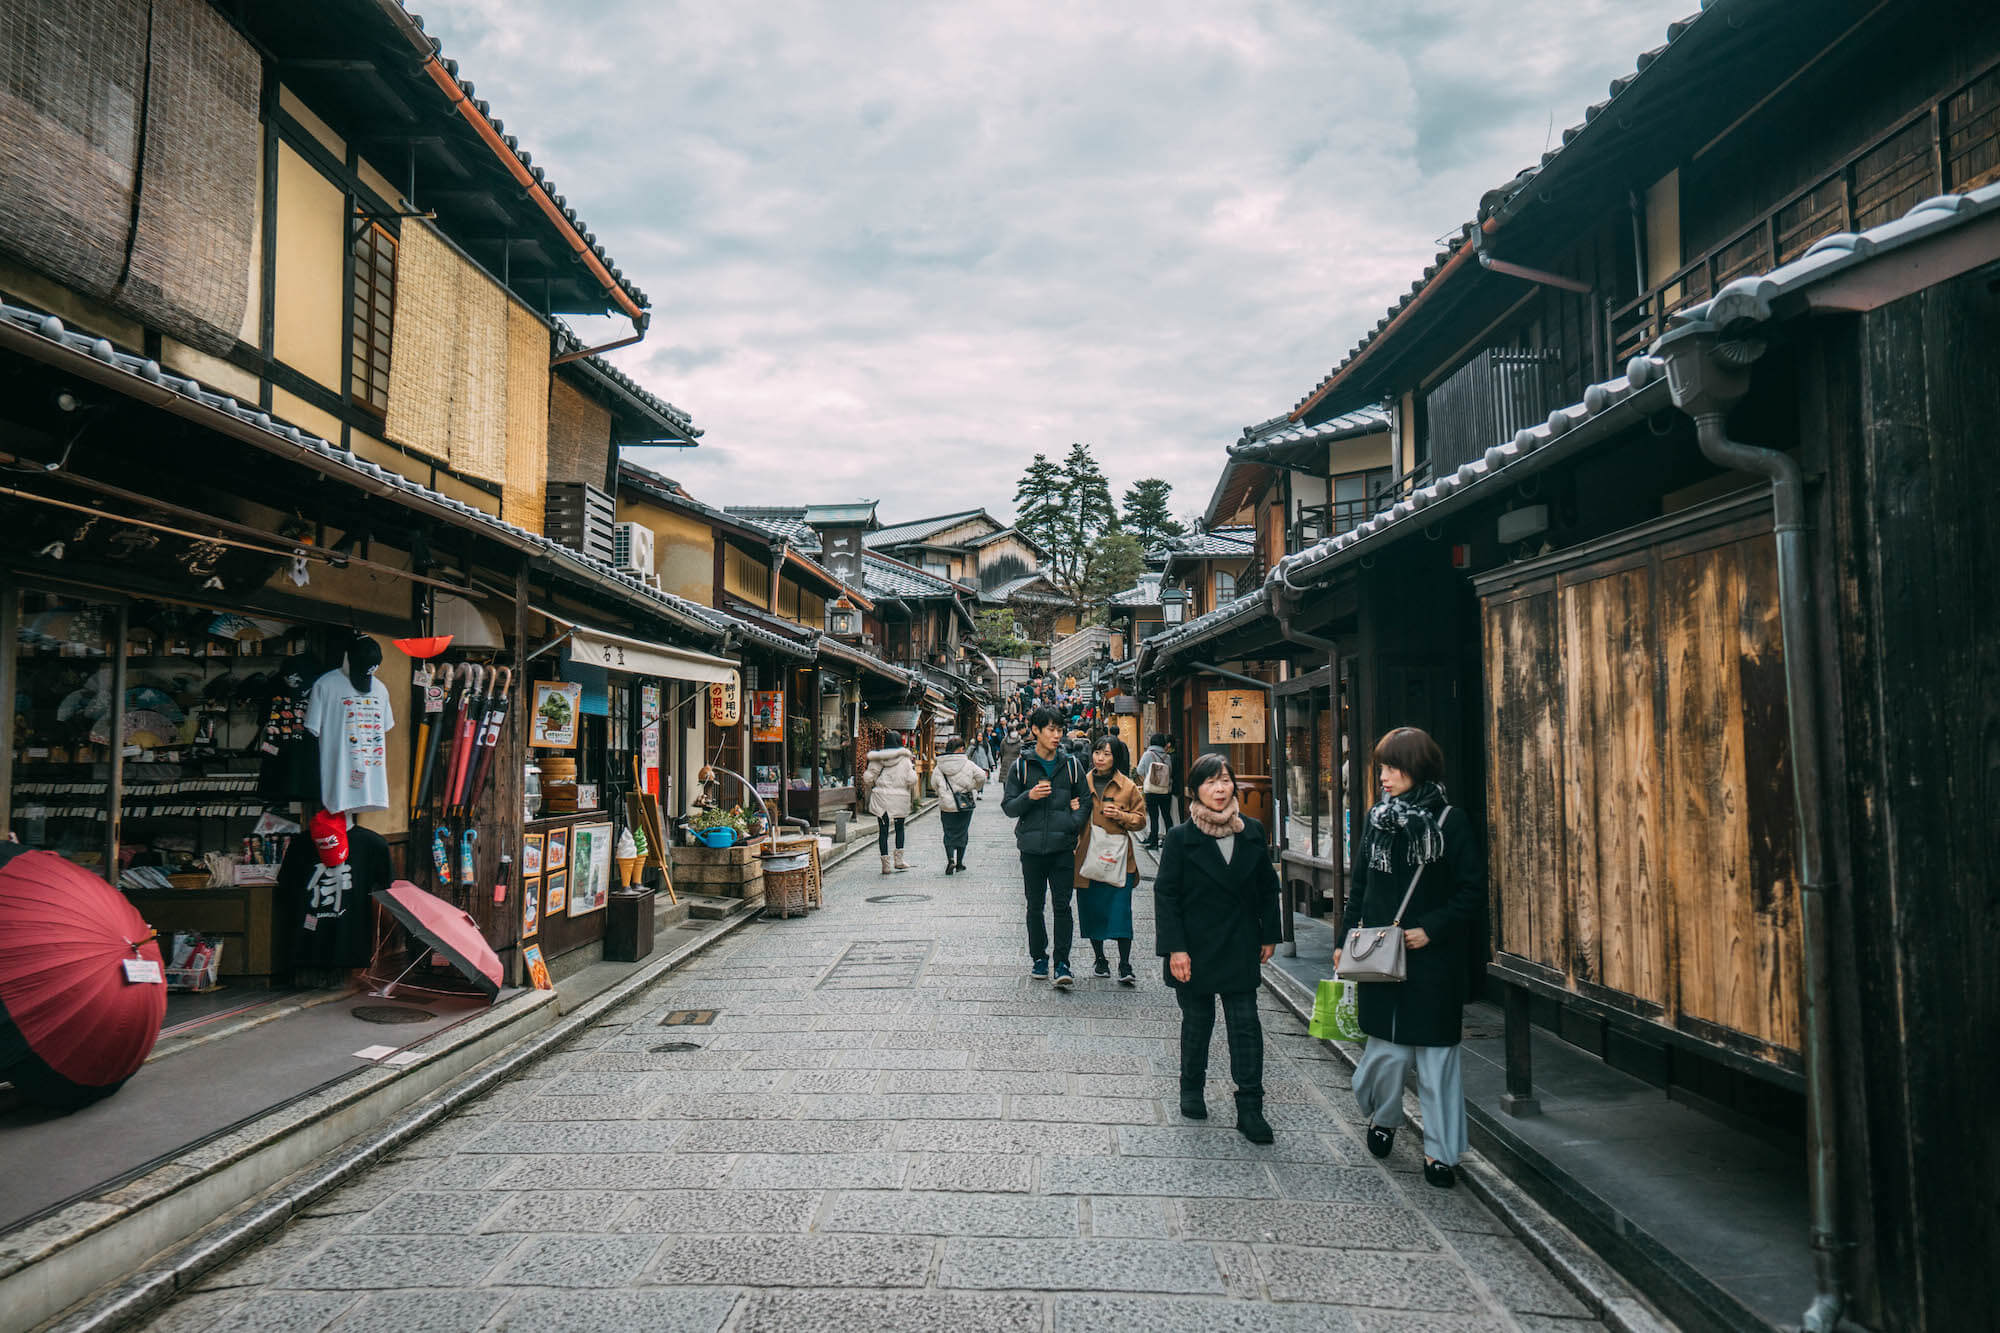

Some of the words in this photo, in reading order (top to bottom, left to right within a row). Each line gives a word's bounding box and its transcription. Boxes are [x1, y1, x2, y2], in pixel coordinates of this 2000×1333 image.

[712, 682, 723, 720] の用心
[725, 673, 737, 719] 締り用心
[307, 862, 353, 913] 侍
